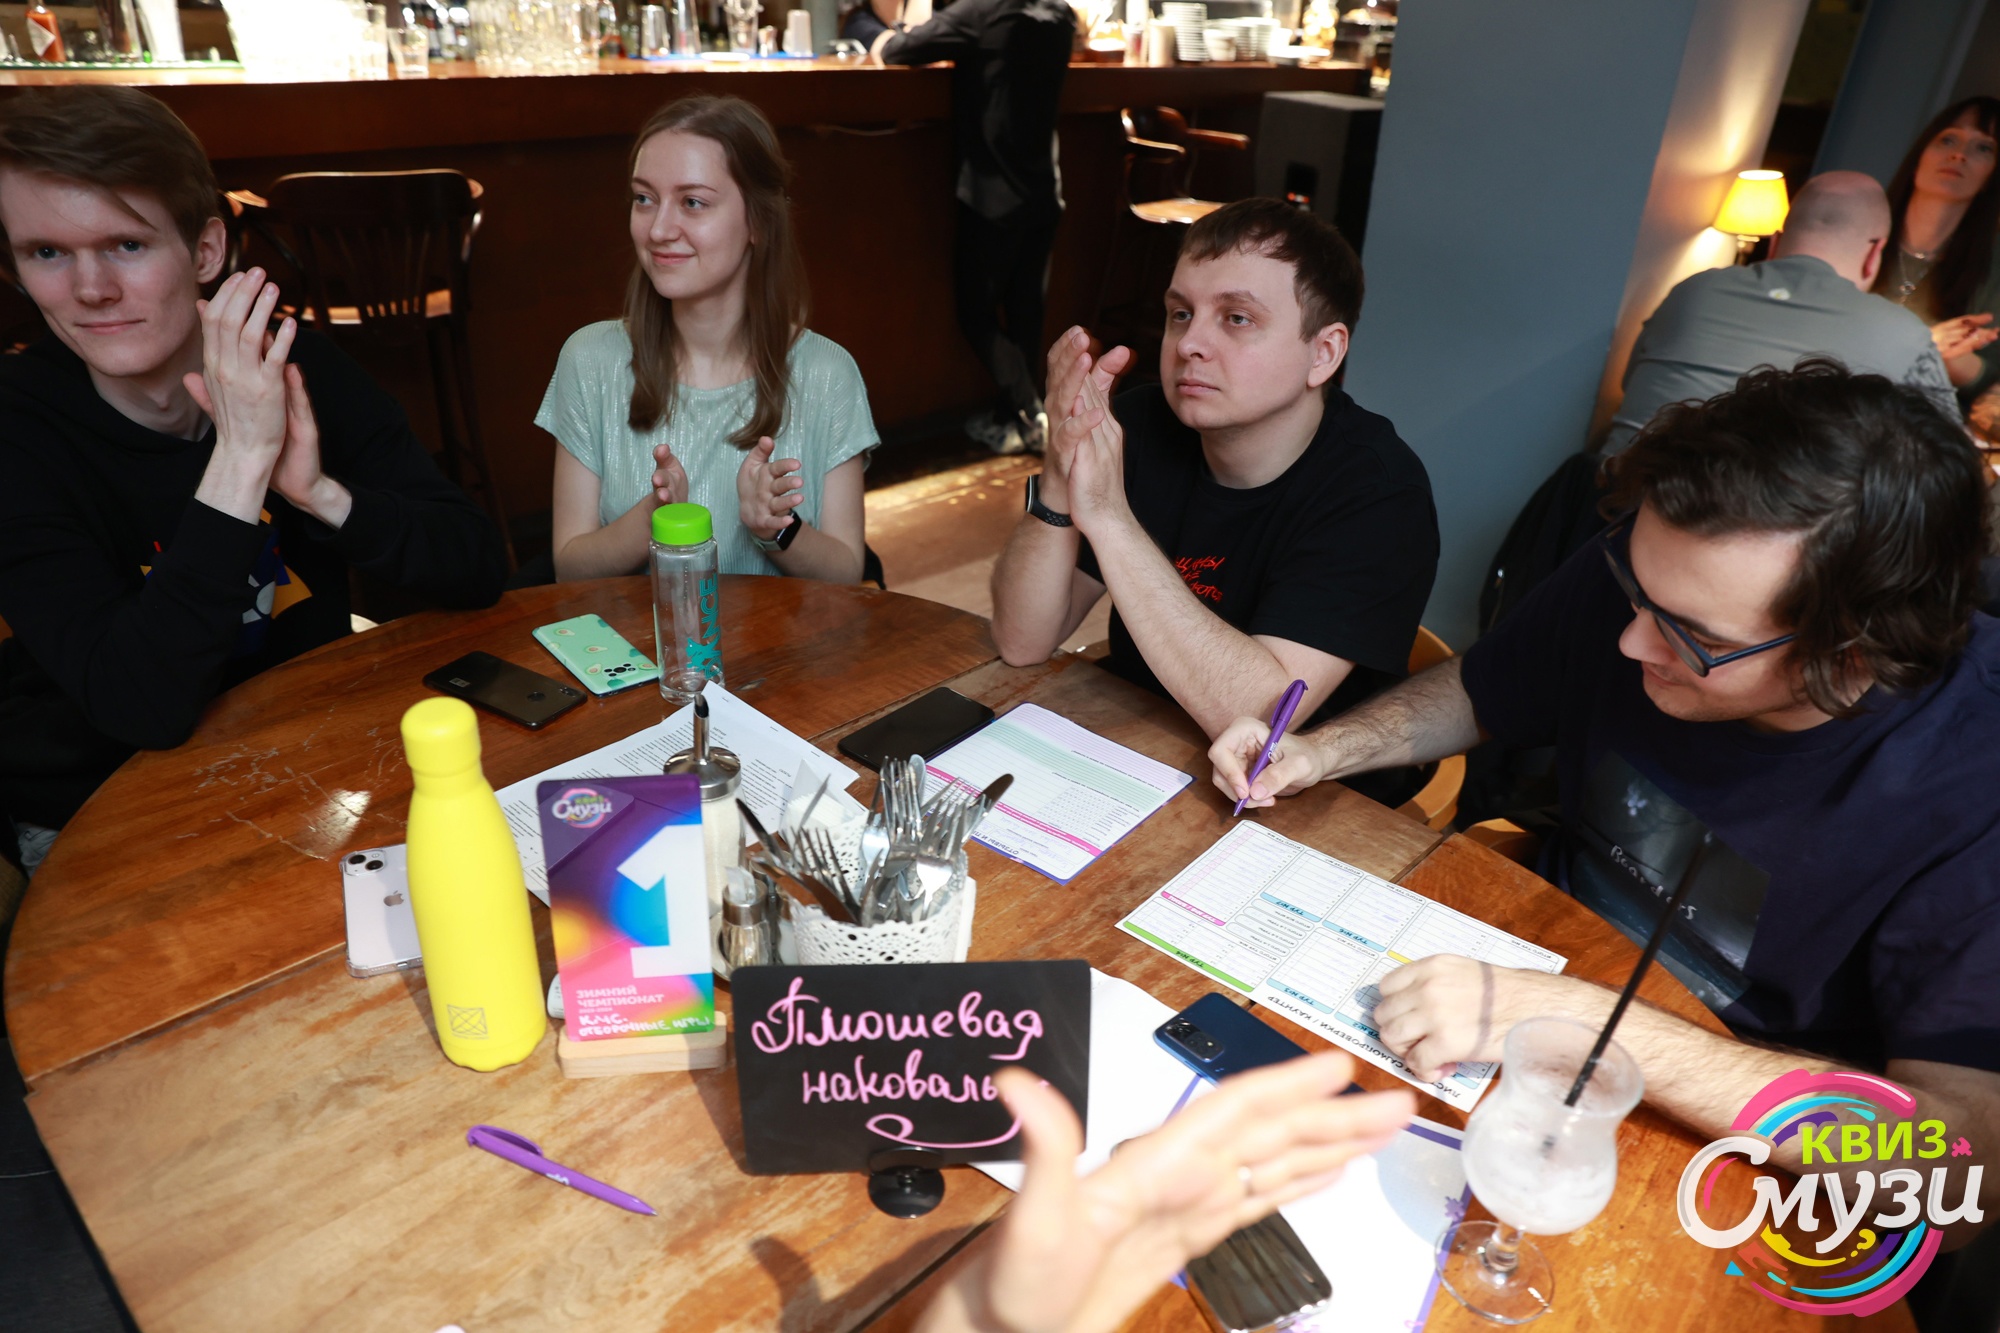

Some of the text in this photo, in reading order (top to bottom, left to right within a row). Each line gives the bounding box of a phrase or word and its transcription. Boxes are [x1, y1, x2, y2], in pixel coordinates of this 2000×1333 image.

[616, 824, 712, 978] 1
[576, 984, 637, 999] ЗИМНИЙ
[577, 994, 664, 1008] ЧЕМПИОНАТ
[803, 1049, 1000, 1104] наковаль
